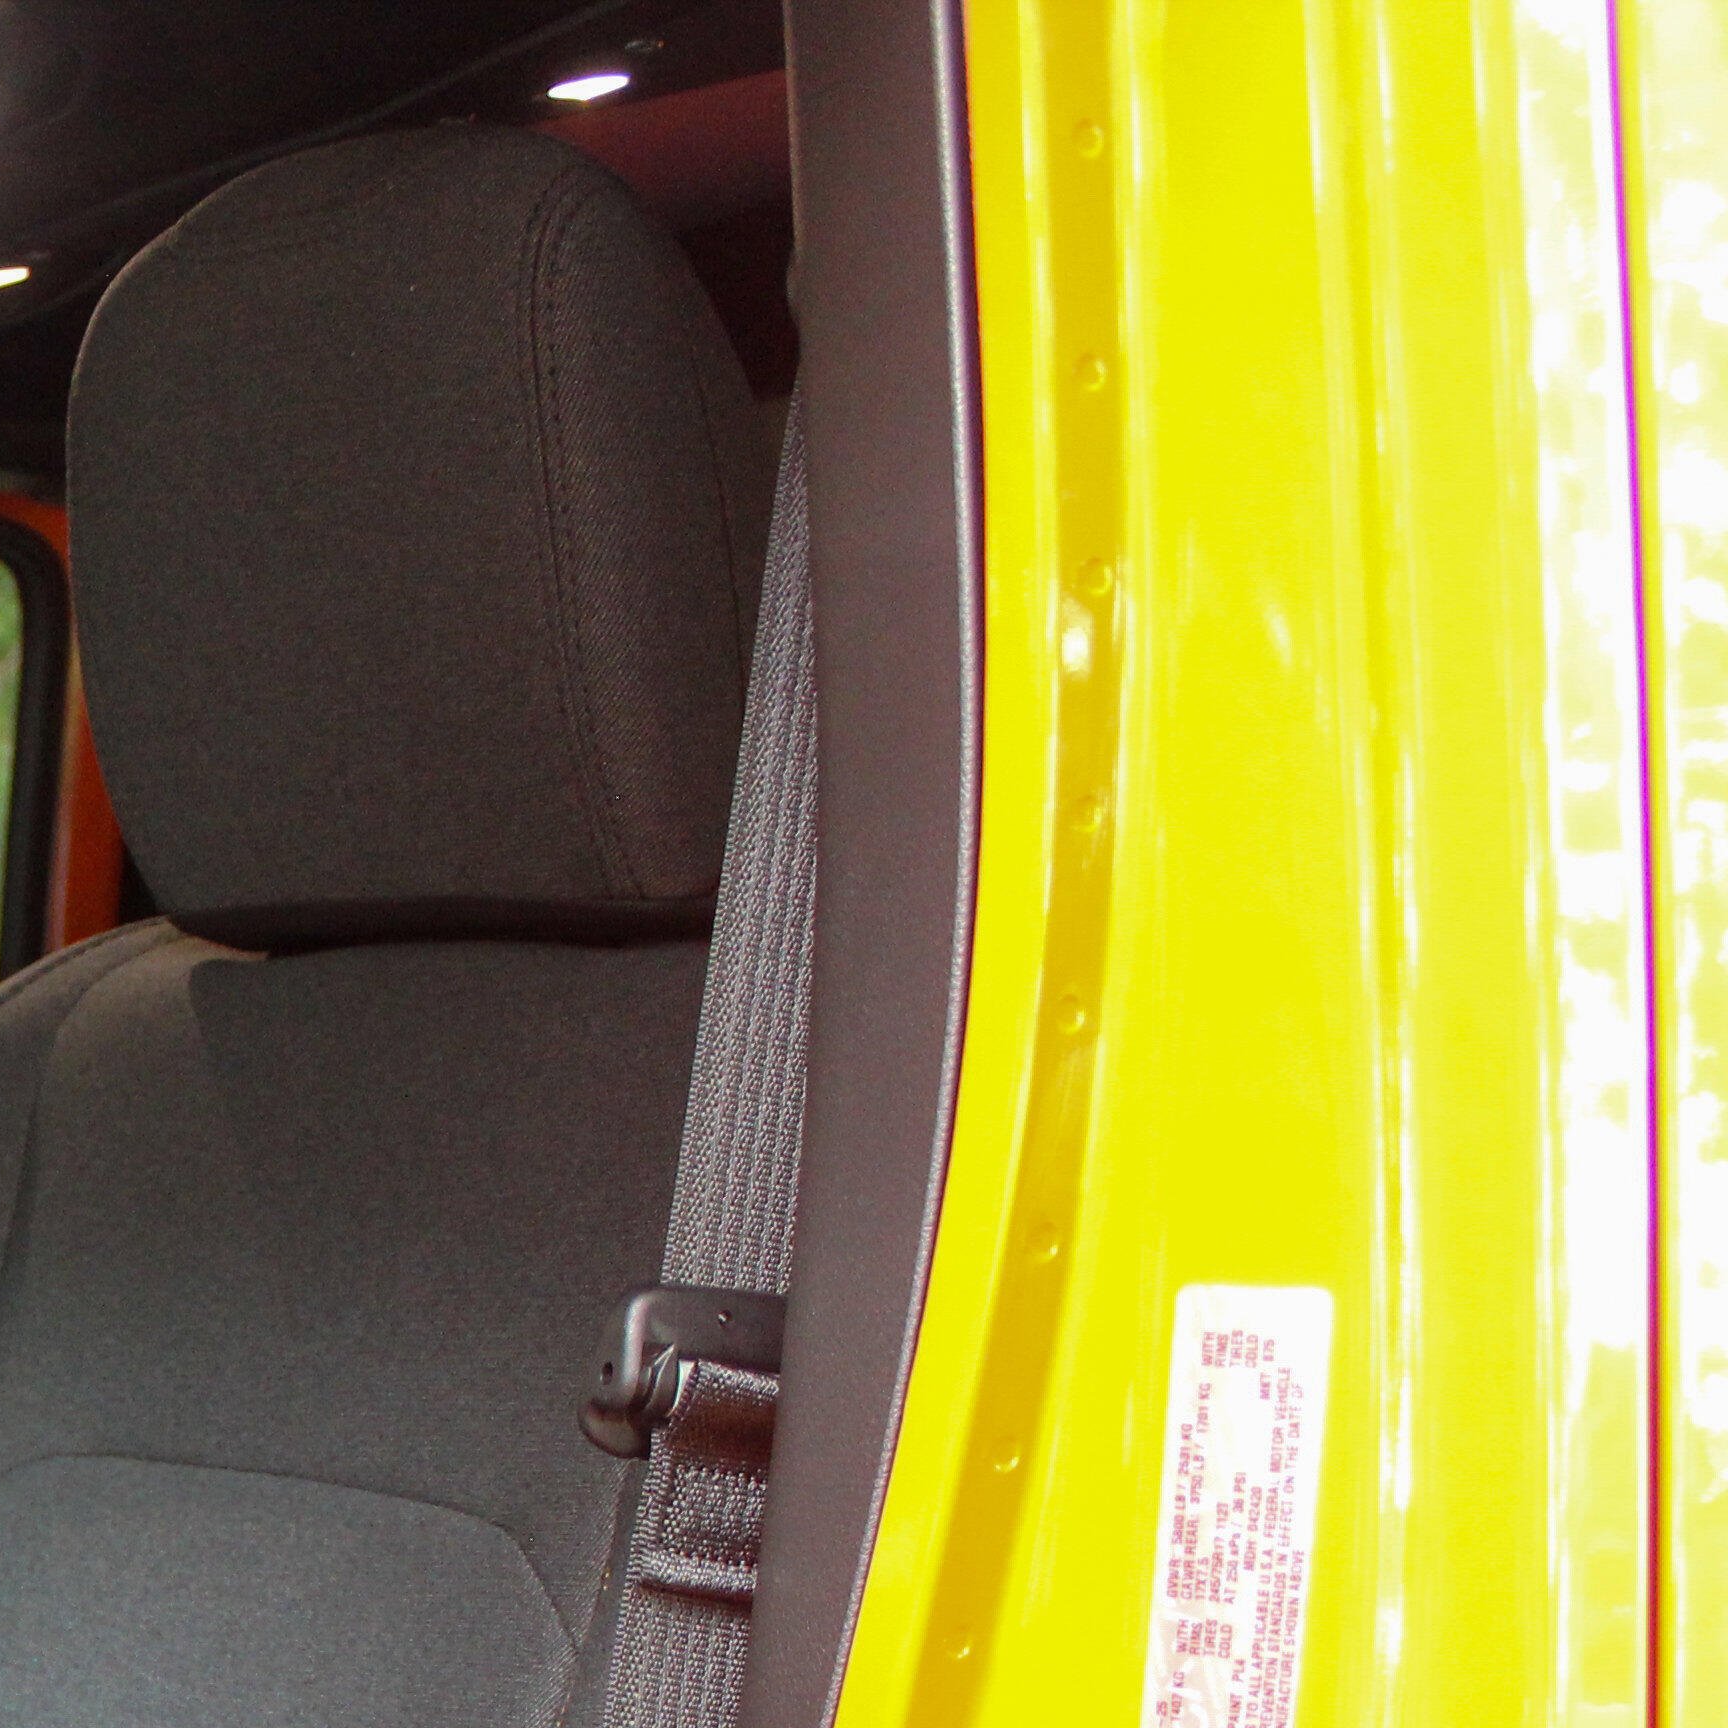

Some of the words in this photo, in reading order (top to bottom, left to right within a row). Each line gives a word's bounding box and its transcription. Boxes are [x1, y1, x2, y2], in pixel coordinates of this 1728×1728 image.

[1202, 1331, 1215, 1367] WITH
[1215, 1333, 1228, 1367] RIMS
[1230, 1329, 1243, 1368] TIRES
[1199, 1382, 1210, 1400] KG
[1275, 1367, 1290, 1421] VEHICLE
[1288, 1406, 1301, 1438] DATE
[1175, 1494, 1187, 1510] LB
[1182, 1423, 1193, 1440] KG
[1224, 1588, 1235, 1604] AT
[1246, 1334, 1258, 1368] COLD
[1270, 1427, 1284, 1473] MOTOR
[1285, 1445, 1297, 1470] THE
[1283, 1475, 1295, 1494] ON
[1264, 1480, 1280, 1538] FEDERAL
[1279, 1500, 1293, 1547] EFFECT
[1277, 1553, 1288, 1566] IN
[1290, 1550, 1303, 1590] ABOVE
[1182, 1560, 1195, 1600] GAWR
[1252, 1589, 1269, 1669] APPLICABLE
[1268, 1572, 1285, 1652] STANDARDS
[1284, 1597, 1299, 1646] SHOWN
[1176, 1618, 1189, 1654] WITH
[1190, 1622, 1202, 1655] RIMS
[1204, 1618, 1218, 1656] TIRES
[1219, 1624, 1232, 1659] COLD
[1249, 1675, 1261, 1697] ALL
[1247, 1702, 1258, 1719] TO
